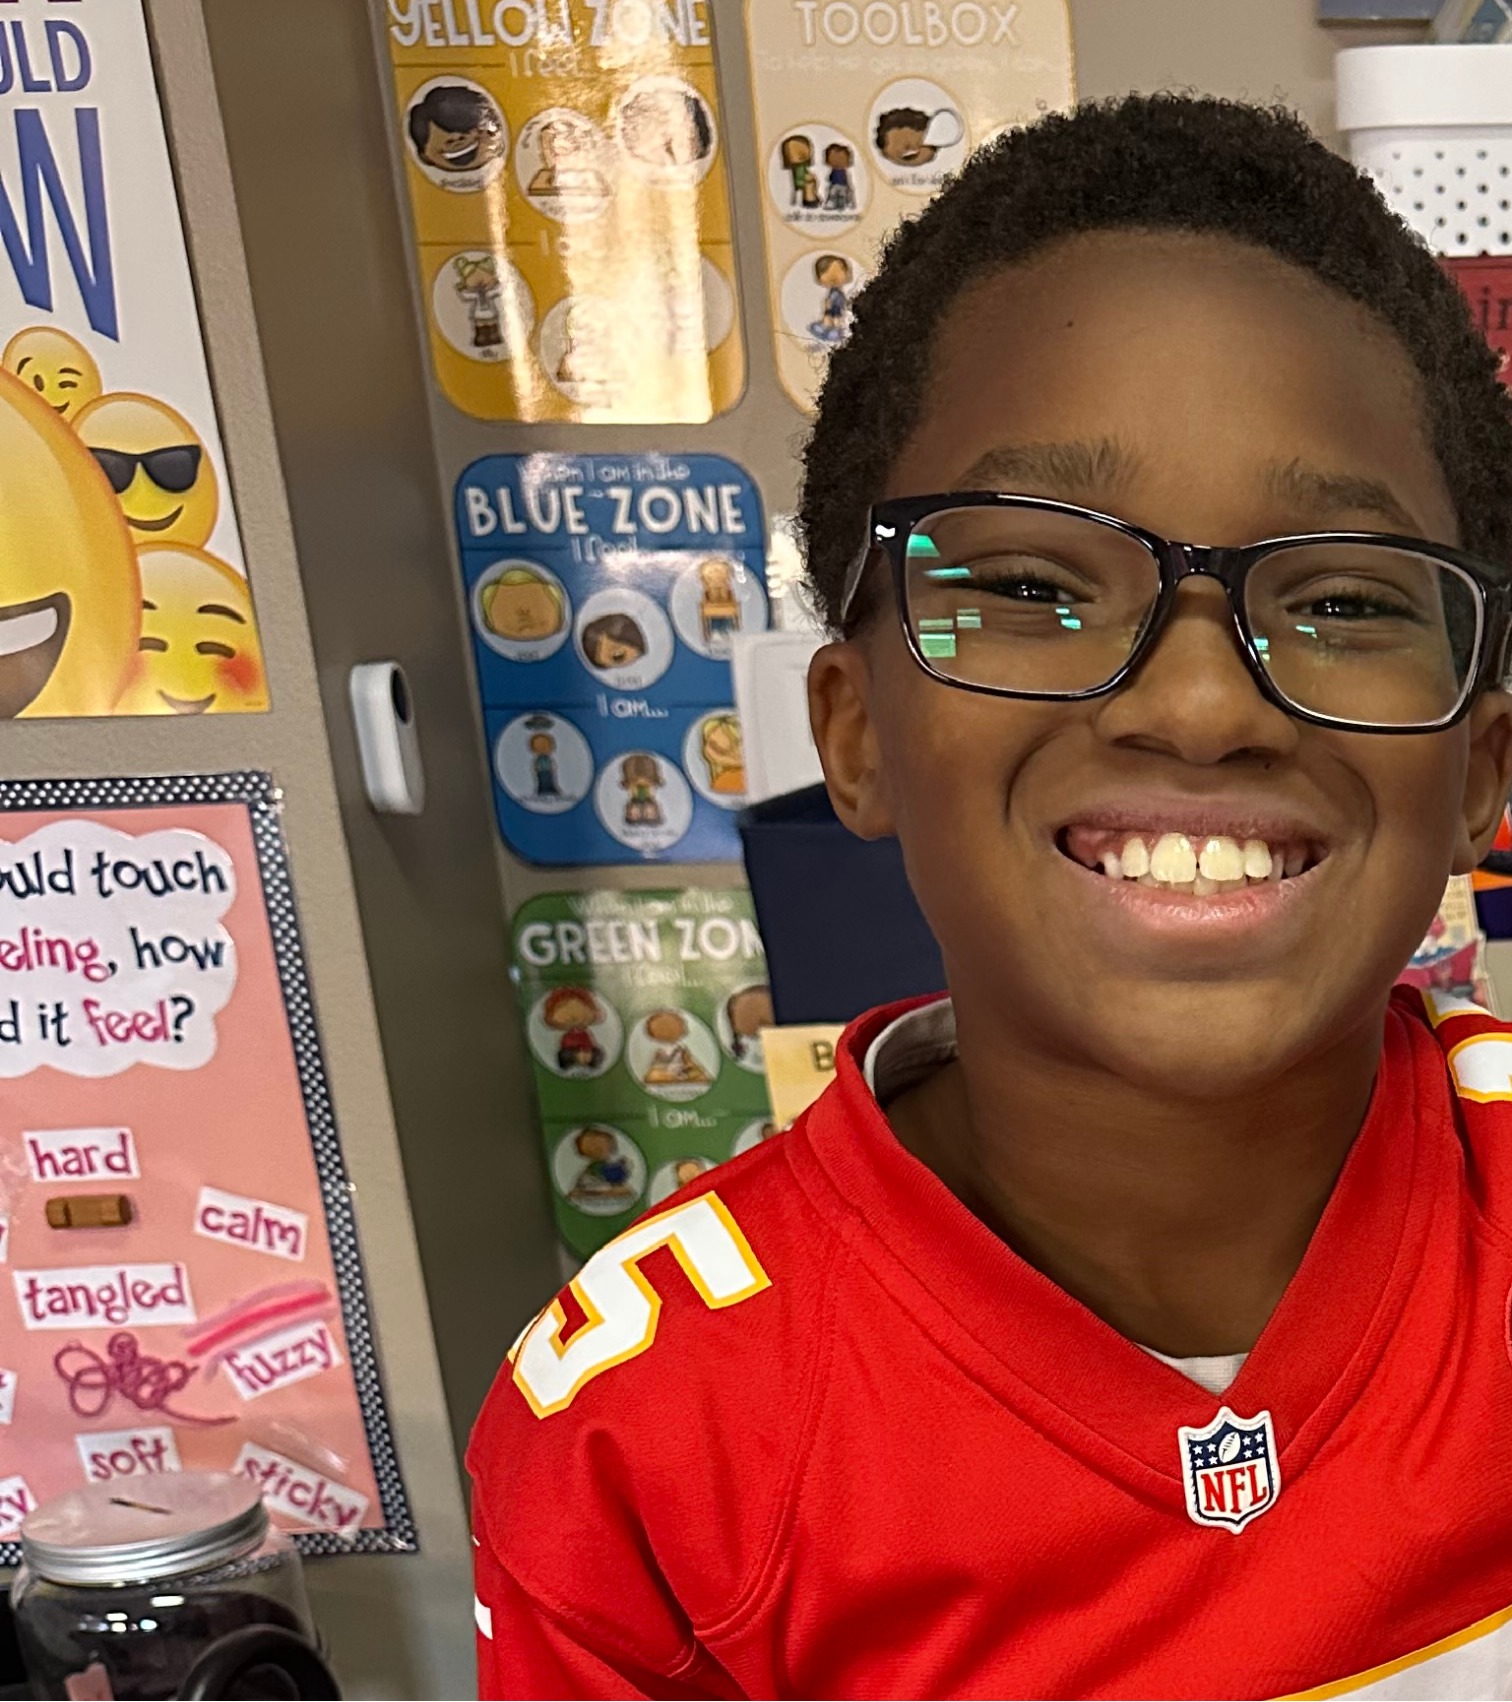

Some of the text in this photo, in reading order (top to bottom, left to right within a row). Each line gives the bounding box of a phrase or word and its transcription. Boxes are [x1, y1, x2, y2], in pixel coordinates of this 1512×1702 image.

[390, 0, 712, 47] YELLOW ZONE
[793, 2, 1020, 46] TOOLBOX
[465, 485, 746, 536] BLUE ZONE
[0, 848, 228, 899] uld touch
[129, 926, 225, 971] how
[519, 916, 766, 967] GREEN ZON
[38, 1002, 72, 1046] it
[82, 995, 196, 1047] feel?
[812, 1039, 835, 1073] B
[29, 1132, 132, 1178] hard
[200, 1203, 303, 1256] calm
[24, 1262, 186, 1325] tangled
[513, 1191, 773, 1420] 5
[224, 1327, 334, 1392] fuzzy
[90, 1436, 169, 1480] soft
[243, 1456, 359, 1528] sticky
[1200, 1463, 1268, 1514] NFL
